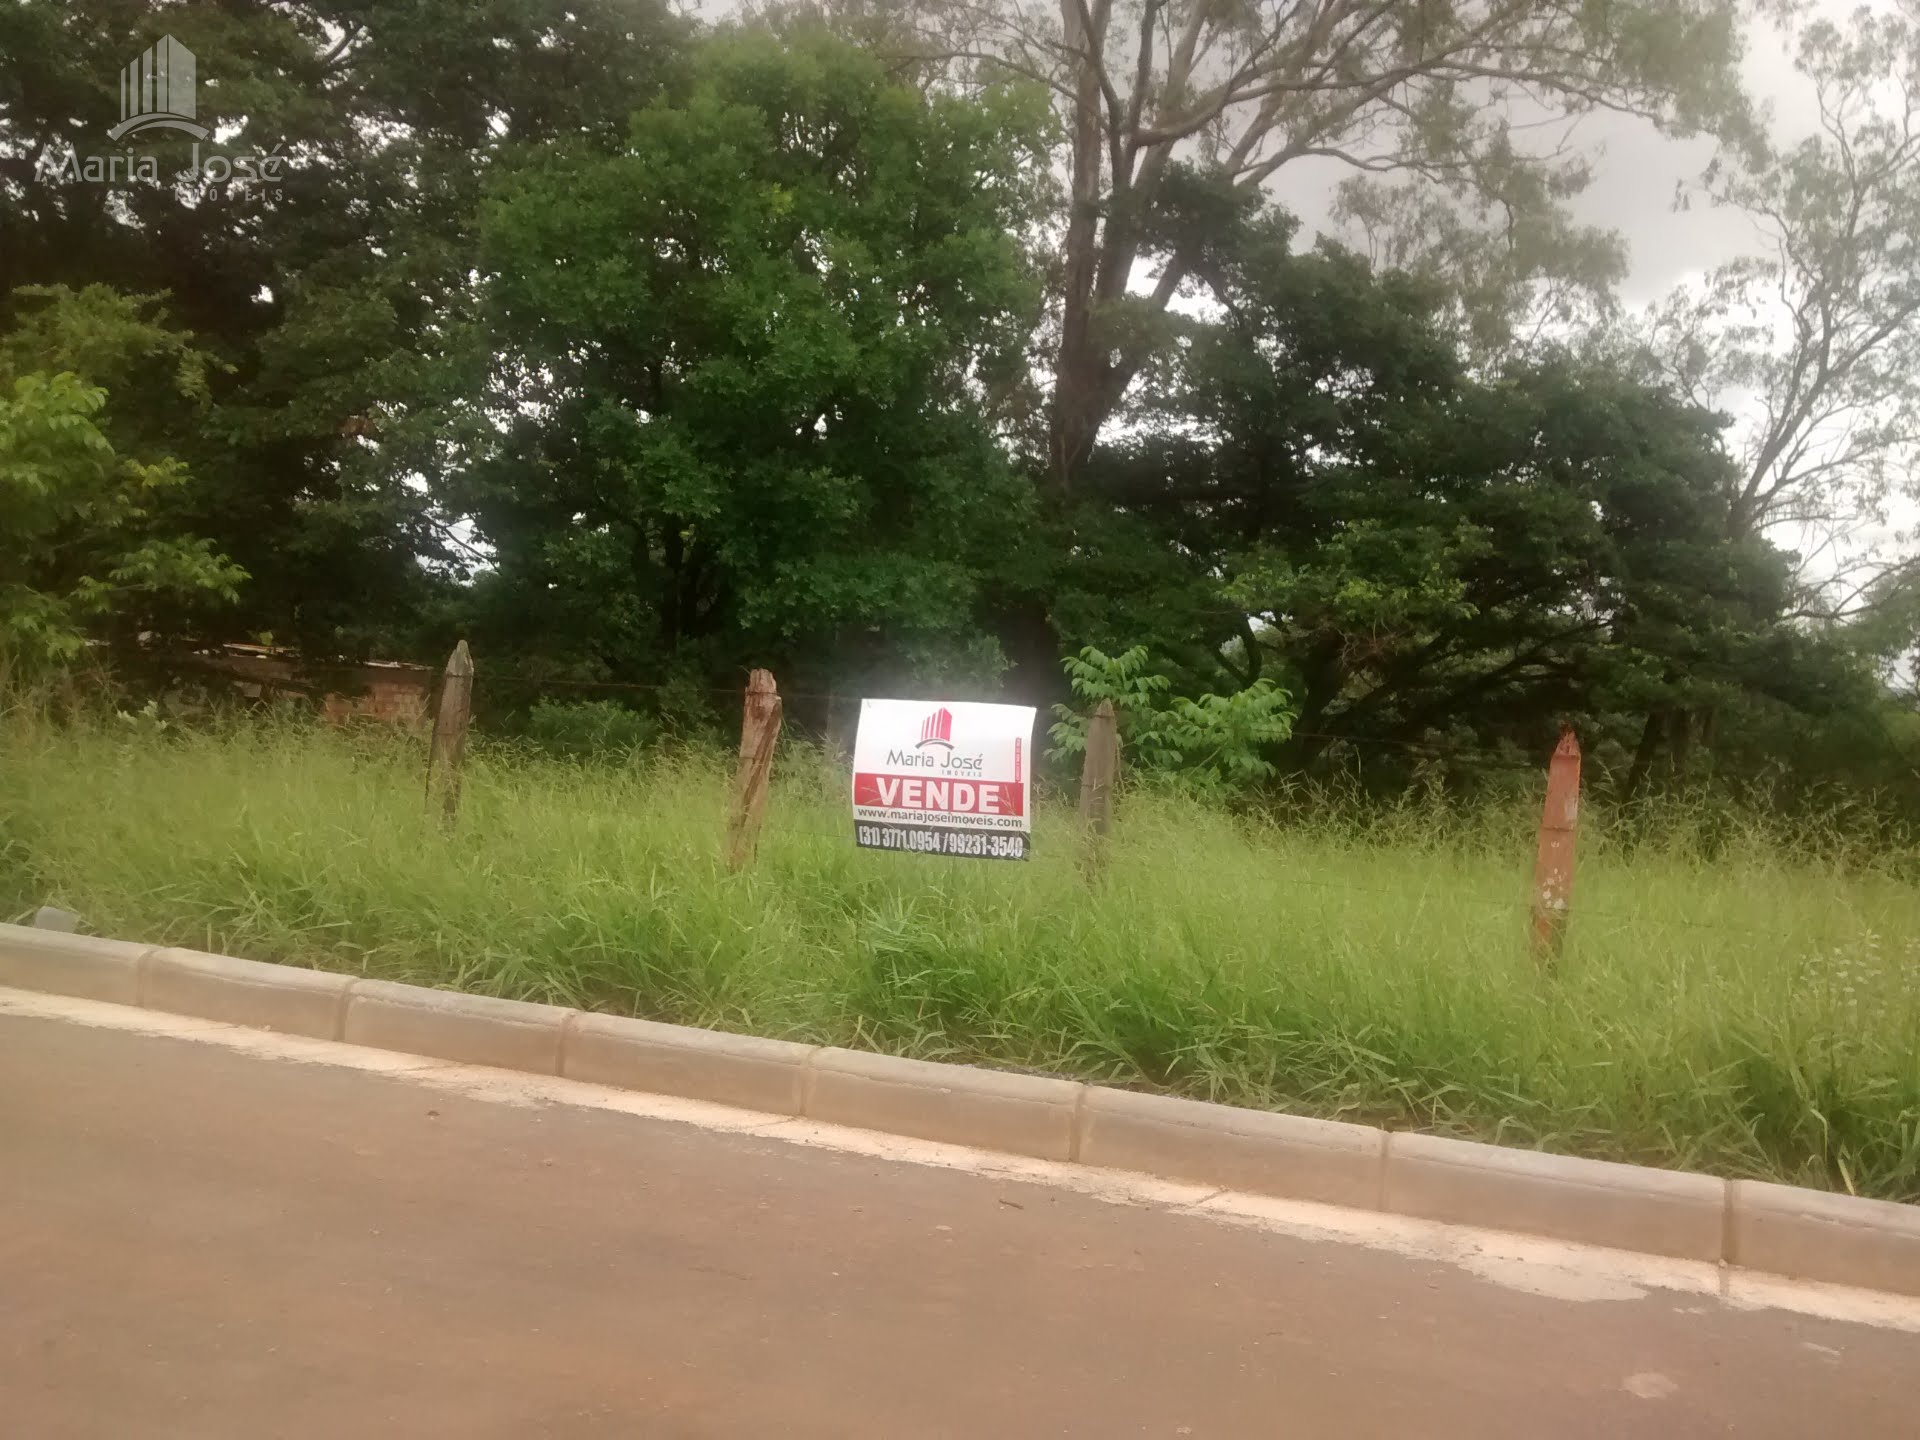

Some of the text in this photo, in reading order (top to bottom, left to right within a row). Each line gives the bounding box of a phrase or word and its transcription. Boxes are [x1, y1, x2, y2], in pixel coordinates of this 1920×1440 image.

[886, 748, 983, 770] Maria José
[876, 777, 1000, 814] VENDE
[857, 808, 1023, 828] www.mariajoseimoveis.com
[859, 825, 880, 846] (31)
